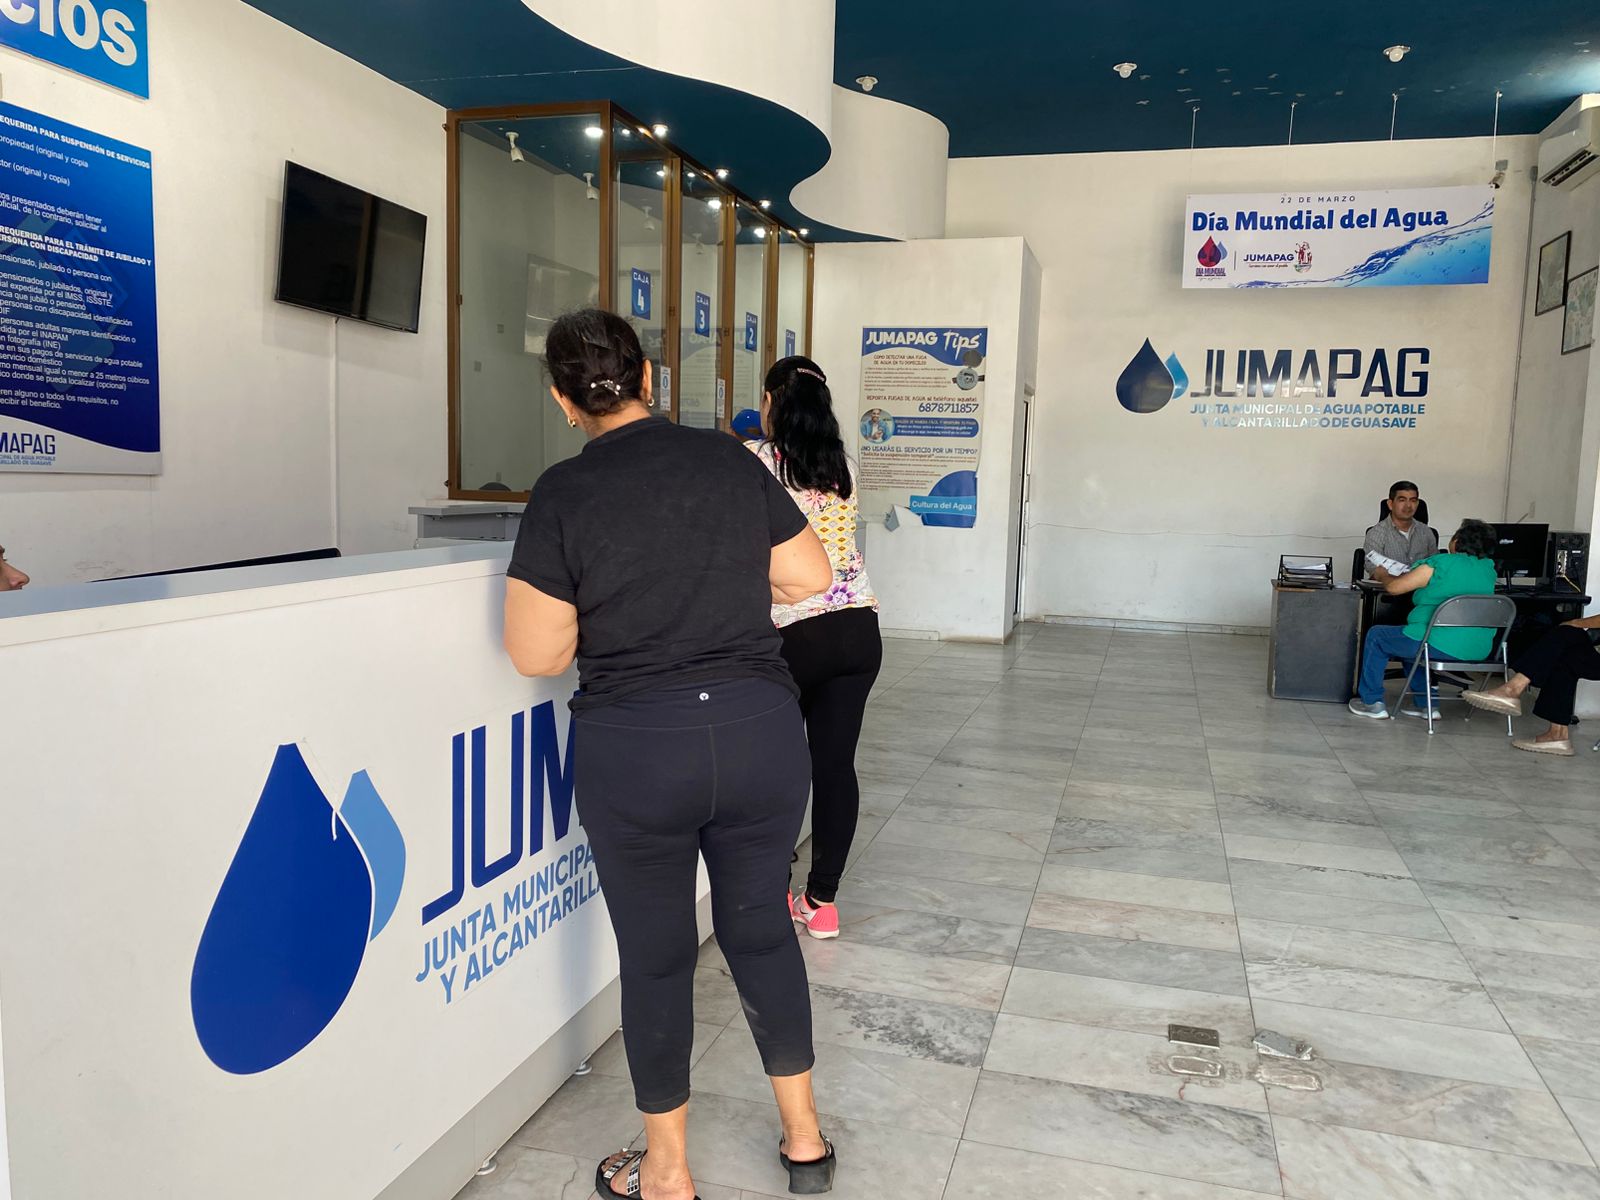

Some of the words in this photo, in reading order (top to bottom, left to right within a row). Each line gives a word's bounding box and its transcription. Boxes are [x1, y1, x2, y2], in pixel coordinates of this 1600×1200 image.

[36, 145, 64, 160] (original
[71, 158, 88, 168] copia
[40, 128, 60, 140] PARA
[106, 149, 116, 158] DE
[116, 153, 150, 169] SERVICIOS
[13, 162, 42, 176] (original
[49, 174, 70, 187] copia)
[12, 196, 55, 212] presentados
[57, 206, 84, 220] deberán
[86, 214, 102, 224] tener
[23, 206, 32, 214] de
[42, 211, 73, 225] contrario,
[75, 219, 100, 231] solicitar
[1192, 211, 1228, 231] Día
[1234, 209, 1333, 231] Mundial
[1340, 208, 1376, 229] del
[1384, 208, 1448, 232] Agua
[0, 225, 43, 242] REQUERIDA
[44, 236, 64, 246] PARA
[66, 241, 74, 249] EL
[75, 242, 104, 256] TRÁMITE
[106, 250, 114, 258] DE
[116, 252, 146, 265] JUBILADO
[30, 241, 46, 250] CON
[47, 244, 98, 262] DISCAPACIDAD
[1243, 254, 1294, 262] JUMAPAG
[38, 260, 66, 273] jubilado
[72, 269, 98, 280] persona
[633, 272, 650, 284] CAJA
[10, 282, 42, 294] expedida
[44, 289, 56, 297] por
[52, 280, 83, 294] jubilados,
[84, 288, 107, 298] original
[638, 288, 645, 311] 4
[696, 295, 709, 306] CAJA
[49, 307, 92, 320] discapacidad
[93, 314, 132, 326] identificación
[699, 310, 705, 330] 3
[0, 317, 34, 328] personas
[35, 322, 60, 332] adultas
[62, 326, 90, 336] mayores
[91, 331, 130, 343] identificación
[40, 331, 68, 342] INAPAM
[749, 328, 754, 344] 2
[42, 340, 60, 351] (INE)
[866, 331, 938, 346] JUMAPAG
[943, 330, 982, 360] Tips
[32, 348, 54, 358] pagos
[65, 353, 93, 362] servicios
[120, 360, 143, 368] potable
[12, 364, 42, 372] mensual
[44, 366, 60, 375] igual
[68, 370, 88, 378] menor
[96, 372, 104, 380] 25
[105, 374, 126, 382] metros
[127, 376, 150, 384] cúbicos
[12, 371, 34, 380] donde
[46, 374, 68, 384] pueda
[68, 378, 94, 386] localizar
[96, 380, 126, 392] (opcional)
[1190, 347, 1430, 398] JUMAPAG
[14, 389, 38, 398] alguno
[46, 392, 64, 400] todos
[66, 394, 76, 402] los
[77, 396, 109, 406] requisitos,
[30, 398, 62, 409] beneficio.
[918, 402, 979, 414] 6878711857
[1190, 404, 1230, 415] JUNTA
[1232, 404, 1302, 415] MUNICIPAL
[1304, 404, 1321, 415] DE
[1323, 404, 1362, 415] AGUA
[1364, 404, 1425, 415] POTABLE
[1202, 417, 1208, 428] Y
[1212, 417, 1330, 428] ALCANTARILLADO
[1332, 417, 1349, 428] DE
[1351, 417, 1416, 428] GUASAVE
[912, 500, 938, 509] Cultura
[940, 501, 952, 509] del
[952, 502, 972, 510] Agua
[416, 902, 496, 983] JUNTA
[440, 965, 457, 1004] Y
[464, 870, 600, 991] ALCANTARILL
